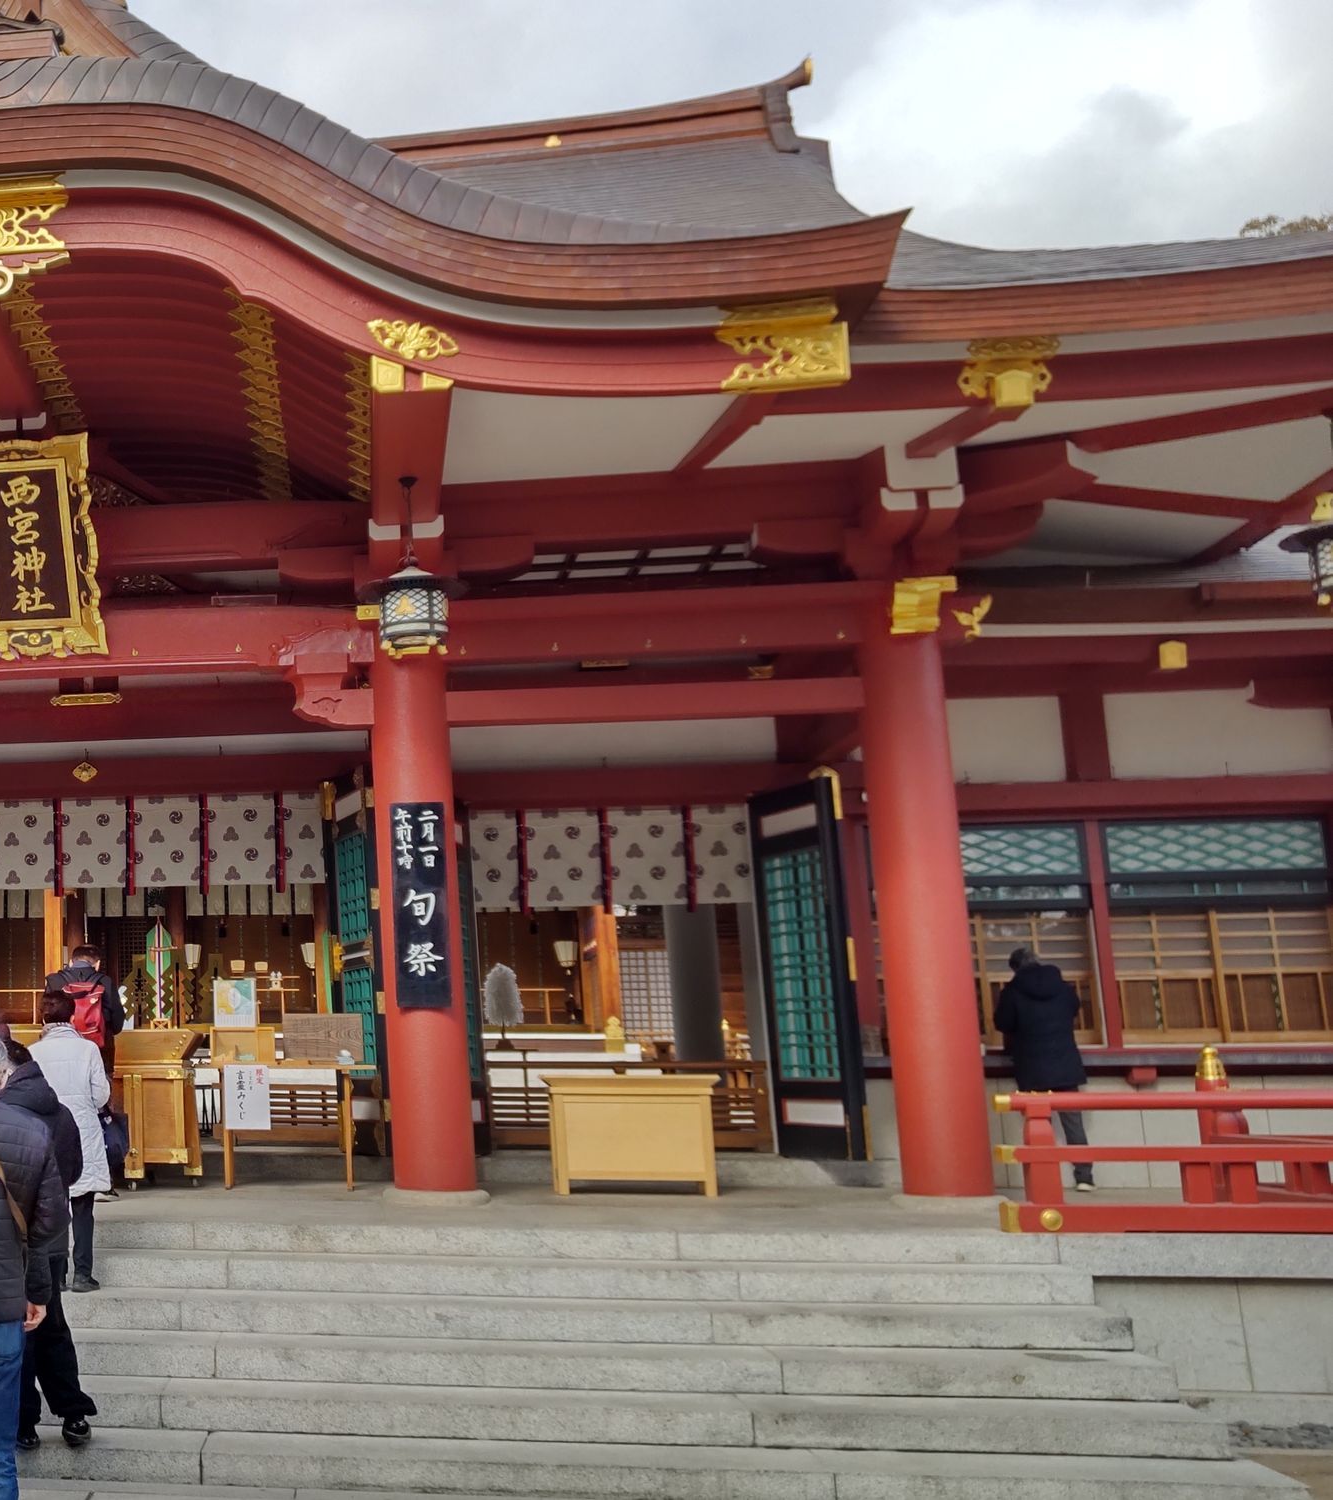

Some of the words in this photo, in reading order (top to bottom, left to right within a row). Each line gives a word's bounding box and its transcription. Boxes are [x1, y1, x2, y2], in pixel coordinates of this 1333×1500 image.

[0, 475, 55, 613] 西宮神社
[394, 808, 414, 870] 午前十時
[418, 809, 439, 868] 二月一日
[402, 888, 445, 977] 旬祭
[236, 1070, 247, 1121] 言霊みくじ
[255, 1068, 265, 1085] 限定
